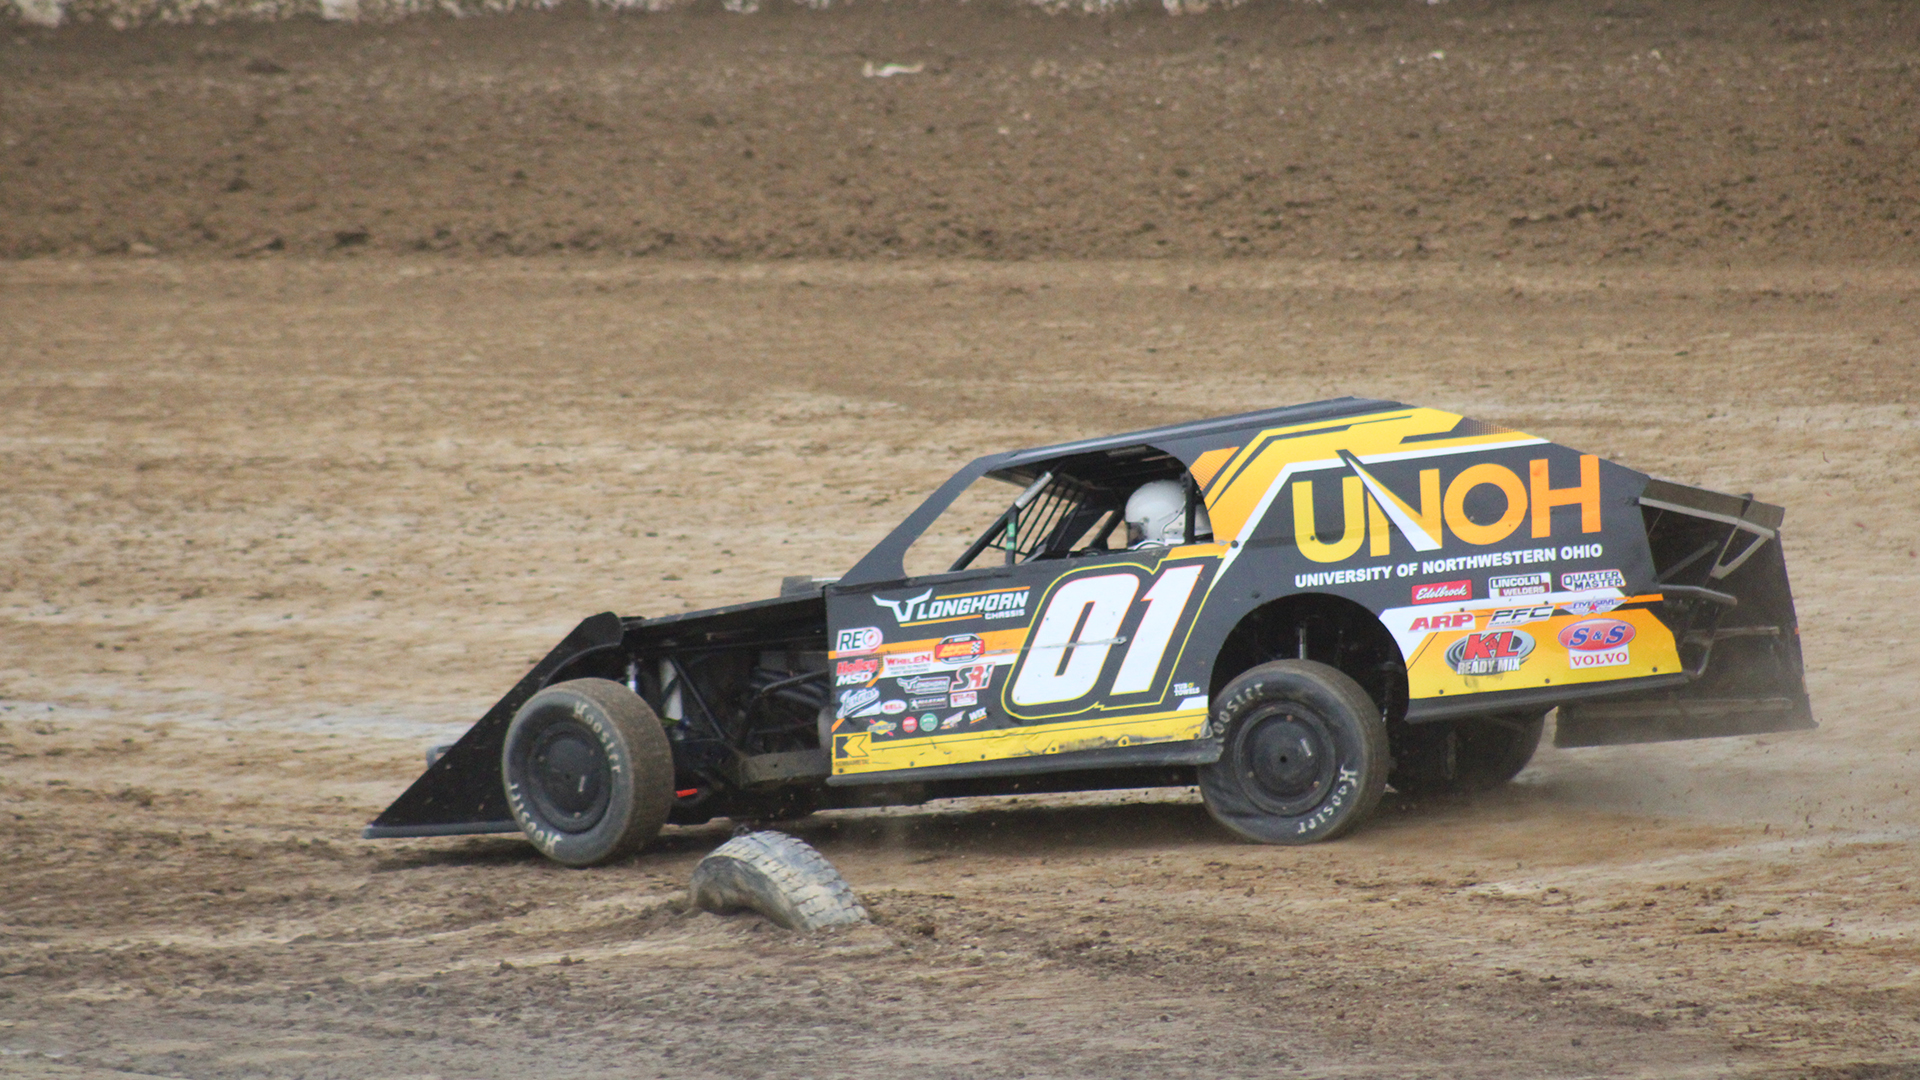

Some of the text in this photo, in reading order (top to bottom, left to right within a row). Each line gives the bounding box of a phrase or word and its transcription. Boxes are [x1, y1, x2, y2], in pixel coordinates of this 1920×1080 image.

[1292, 453, 1602, 563] UNOH
[1294, 543, 1603, 588] UNIVERSITY OF NORTHWESTERN OHIO
[1491, 575, 1540, 589] LINCOLN
[1563, 571, 1620, 586] QUARTER
[1574, 578, 1623, 592] MASTER
[1415, 584, 1468, 600] Edelbrock
[1503, 586, 1546, 597] WELDERS
[916, 591, 1030, 620] LONGHORN
[1490, 605, 1554, 622] PFC
[984, 608, 1026, 620] CHASSIS
[1409, 613, 1474, 631] ARP
[1011, 564, 1204, 706] 01
[1457, 657, 1521, 676] READY MIX
[1571, 651, 1628, 667] VOLVO
[836, 671, 873, 687] MSD
